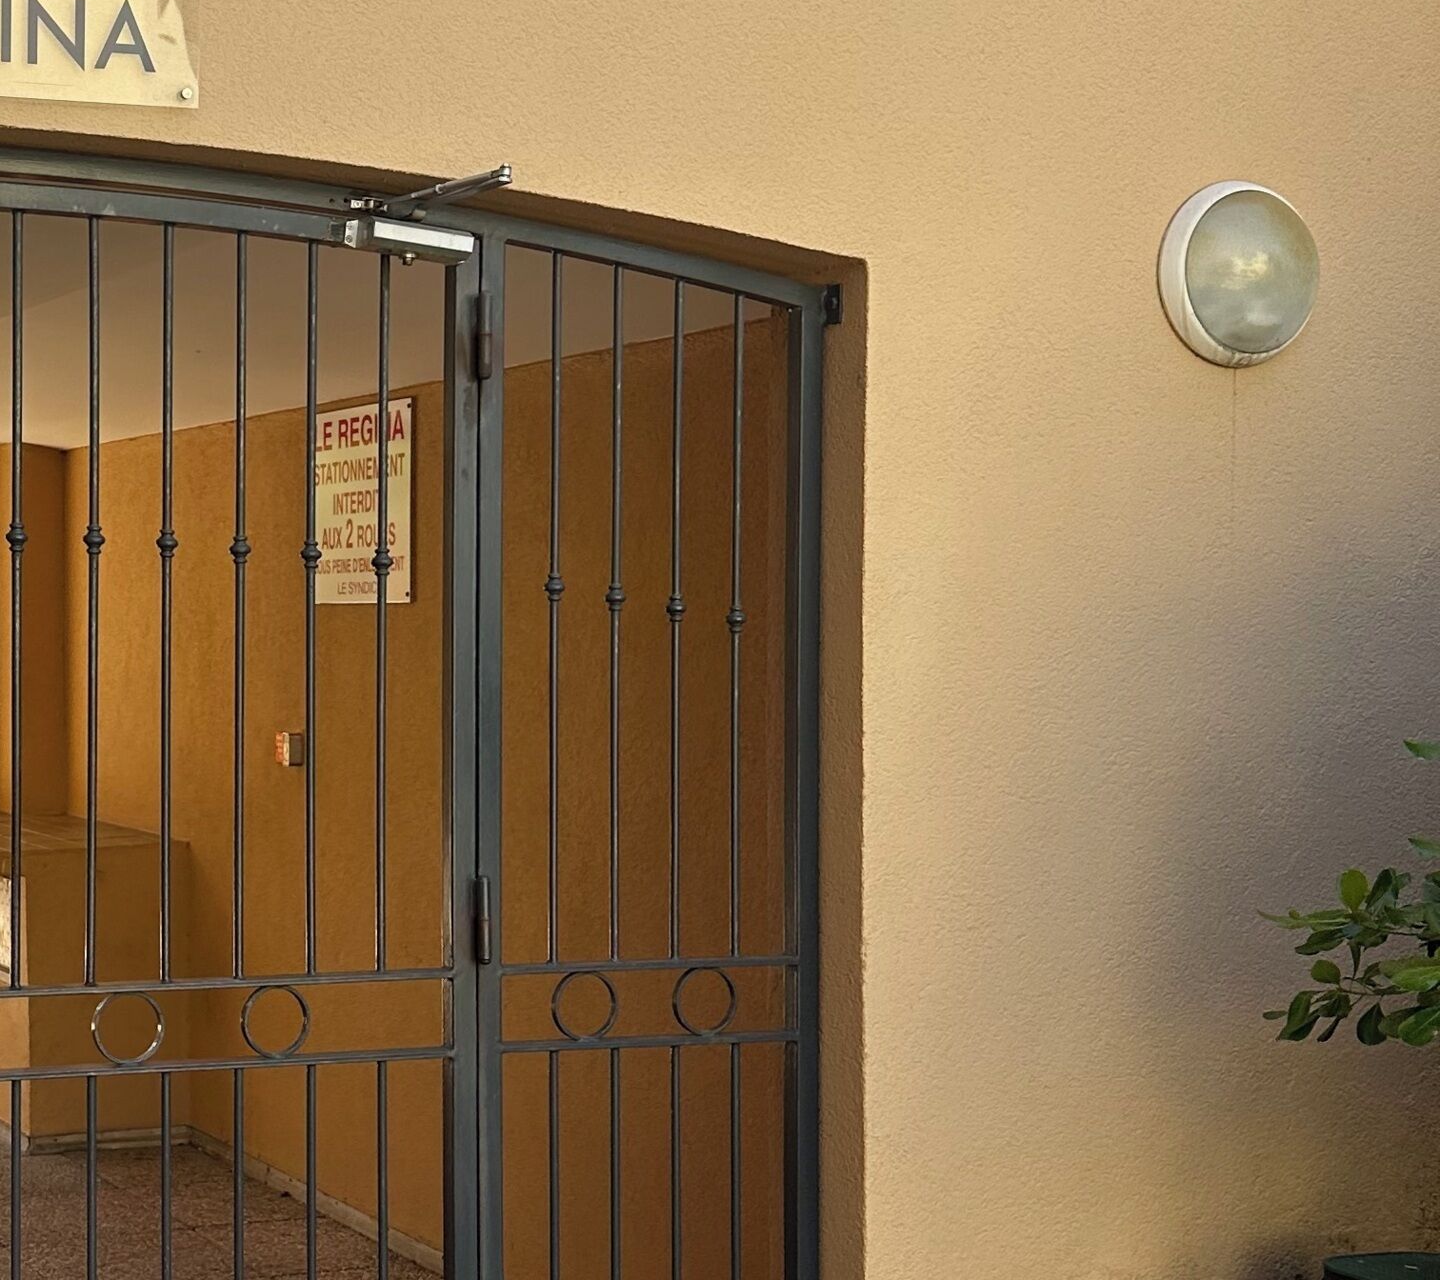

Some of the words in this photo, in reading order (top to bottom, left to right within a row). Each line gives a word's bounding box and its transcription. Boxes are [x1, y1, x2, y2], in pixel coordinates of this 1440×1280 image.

[315, 453, 405, 486] STATIONNENT
[333, 489, 378, 515] INTERDI
[322, 526, 342, 550] AUX
[346, 518, 353, 549] 2
[357, 522, 396, 548] ROUS
[316, 560, 331, 574] OUS
